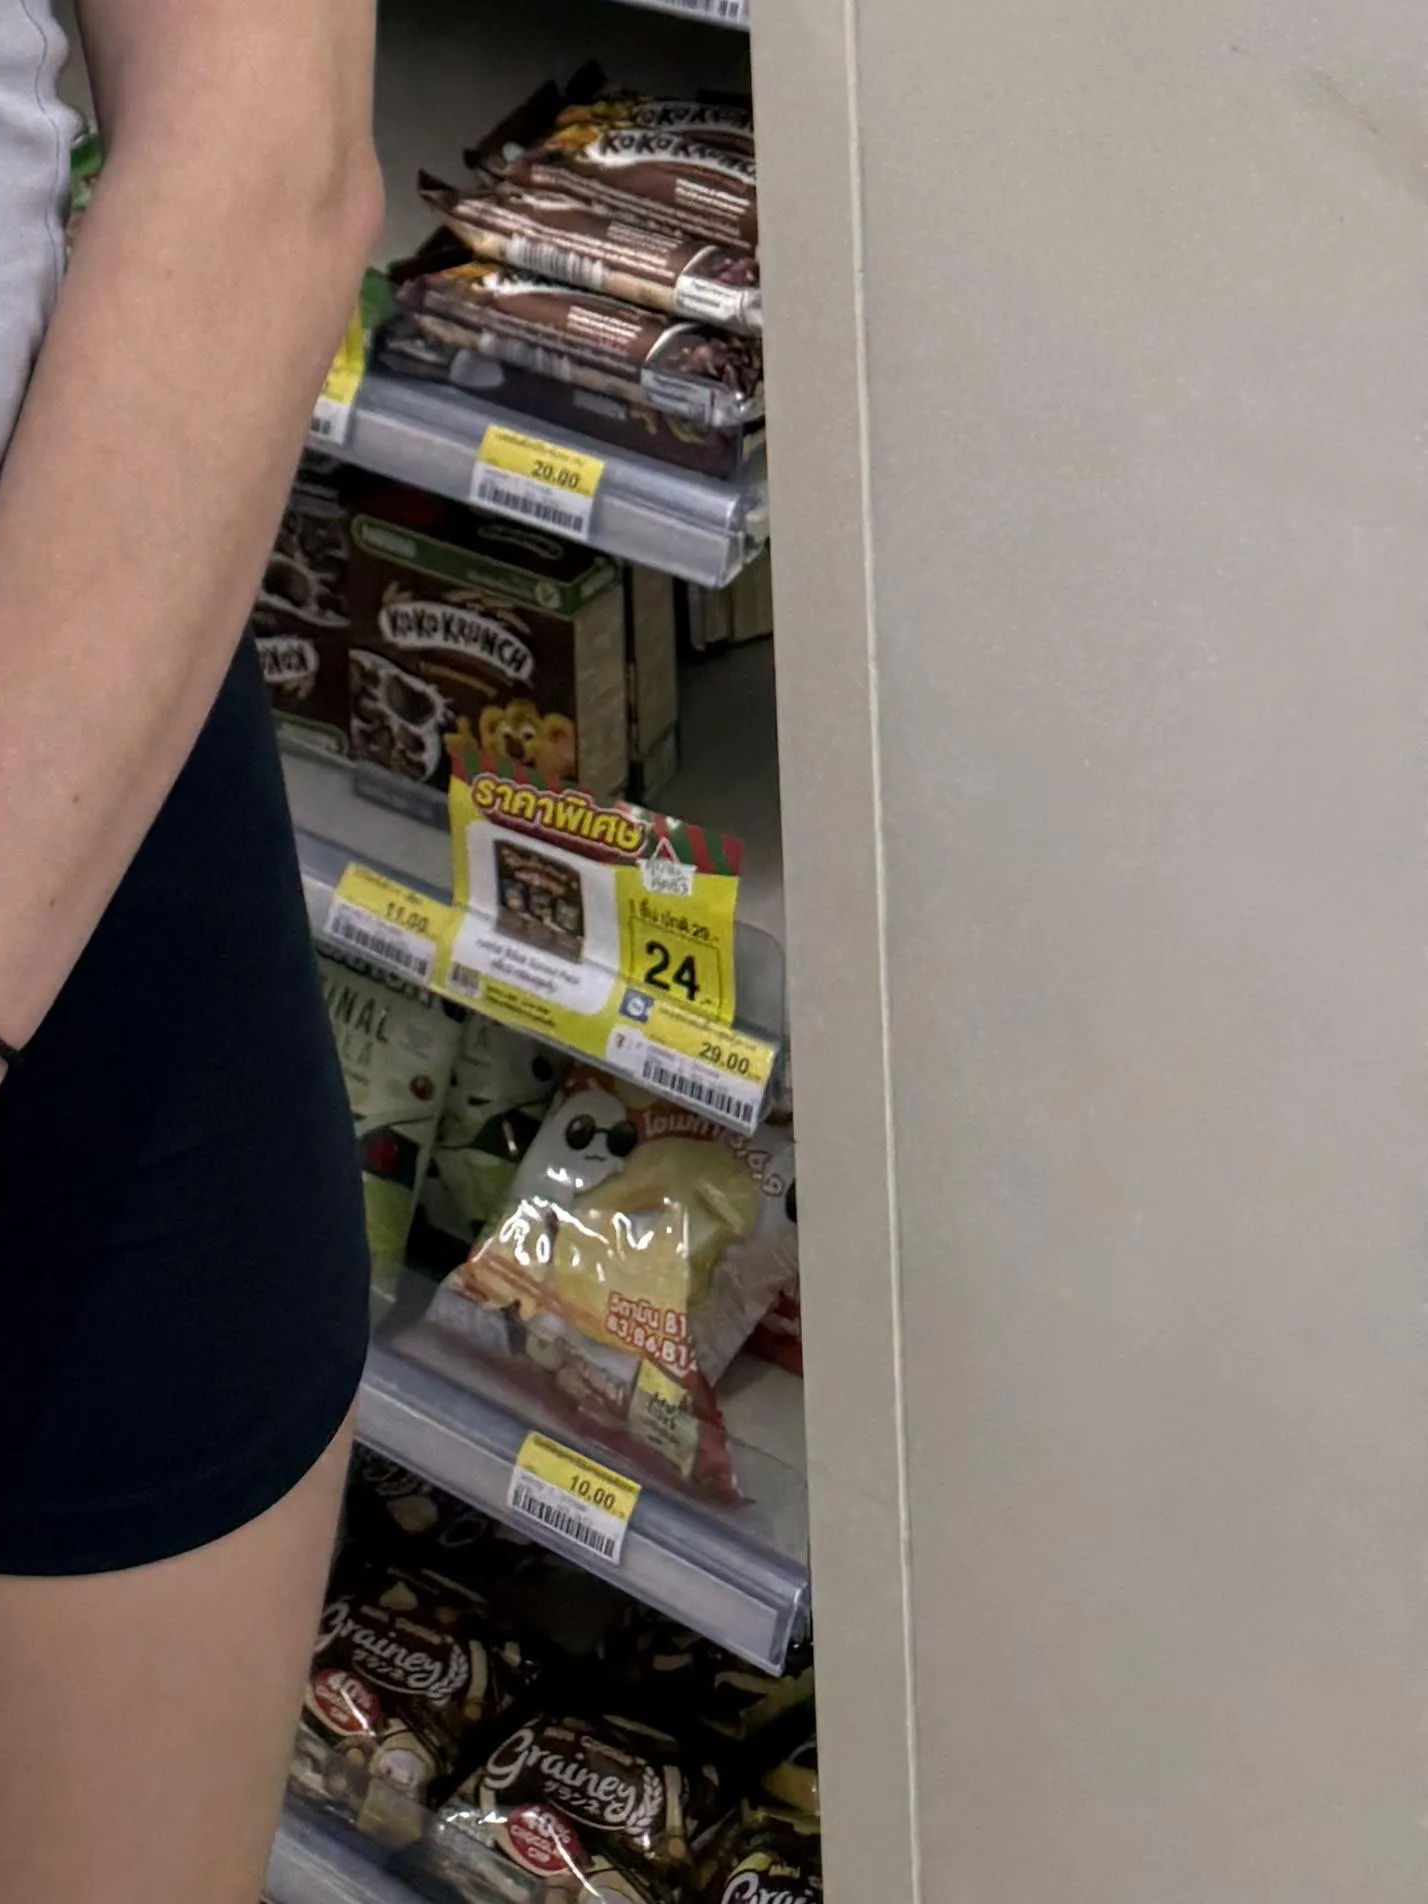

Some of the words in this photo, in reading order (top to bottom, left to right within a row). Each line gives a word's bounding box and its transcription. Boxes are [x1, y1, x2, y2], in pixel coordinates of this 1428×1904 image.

[442, 608, 529, 674] KRUNCH
[474, 776, 642, 853] ราคาพิเศษ
[697, 1041, 750, 1076] 29.00
[568, 1474, 616, 1511] 10.00
[484, 1728, 637, 1824] Grainey
